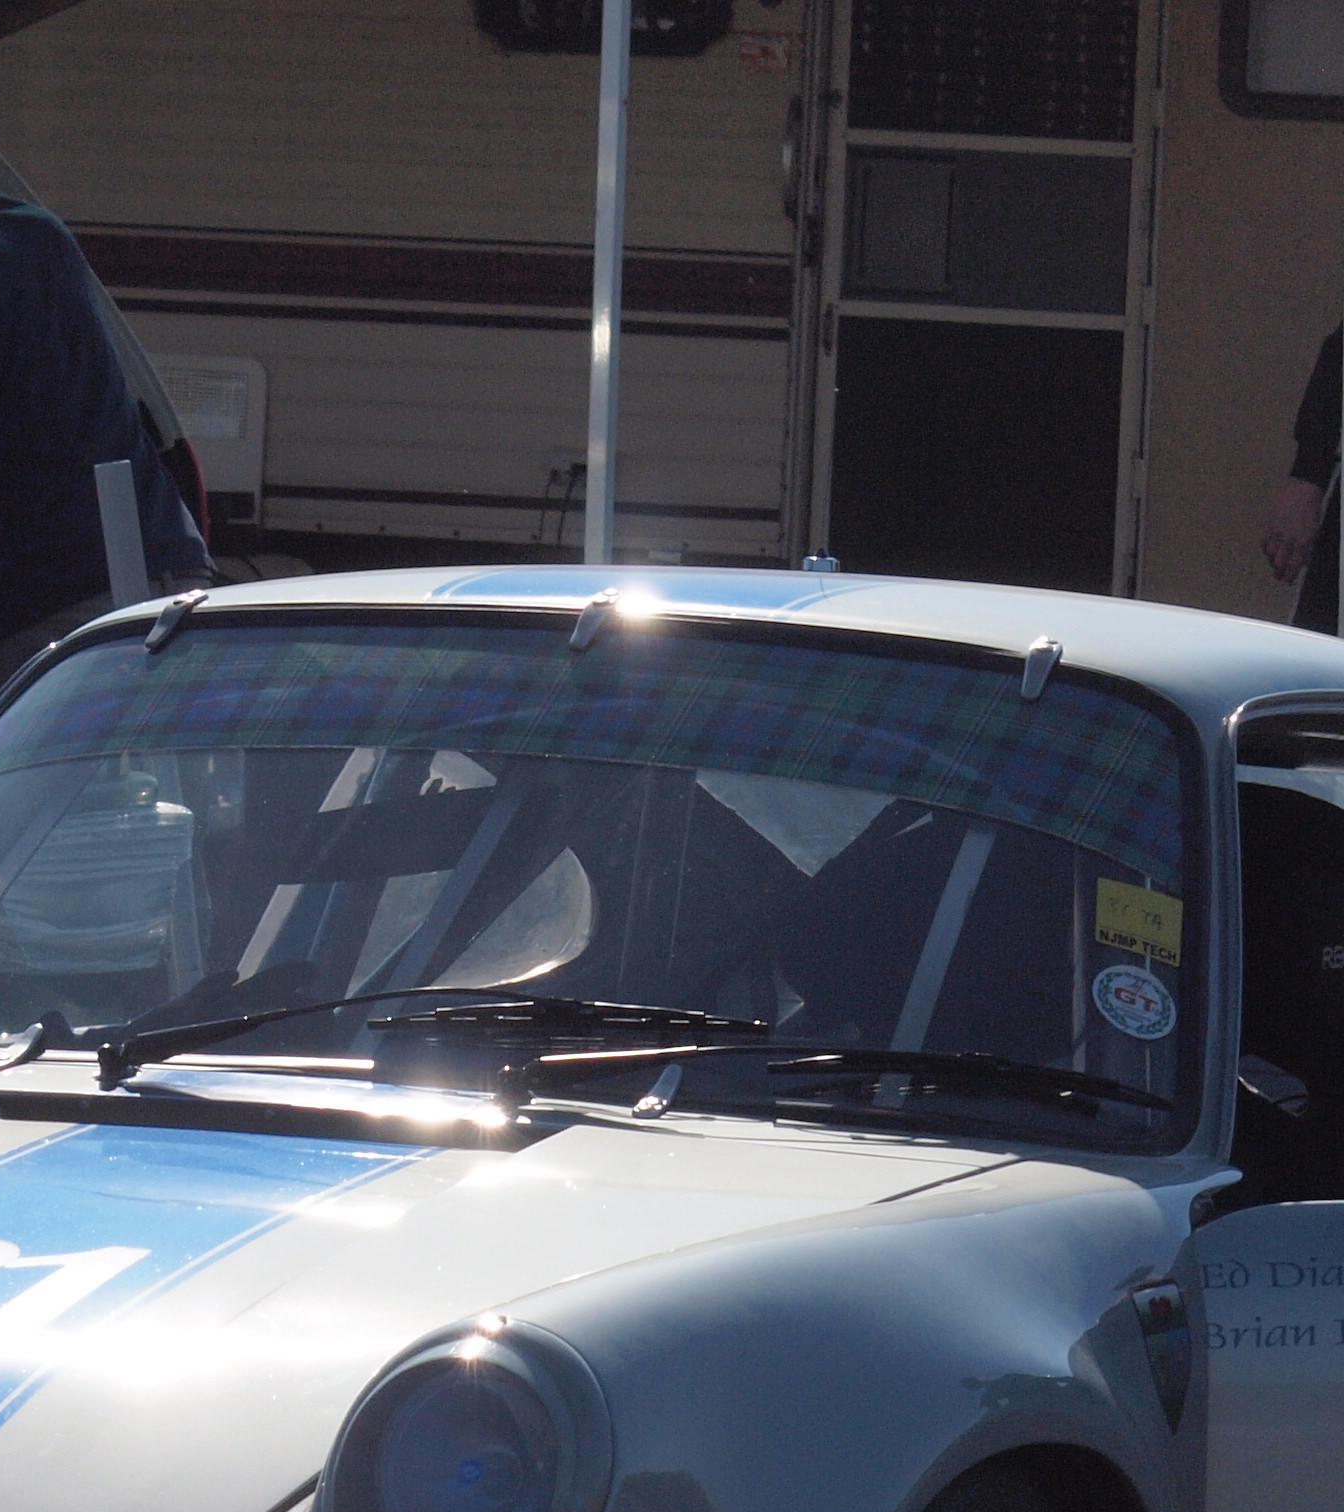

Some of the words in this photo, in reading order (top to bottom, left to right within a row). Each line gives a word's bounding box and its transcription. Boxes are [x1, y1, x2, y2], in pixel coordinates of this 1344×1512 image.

[1142, 941, 1176, 963] TECH
[1113, 985, 1159, 1013] GT
[1199, 1259, 1251, 1290] Ed
[1207, 1316, 1317, 1350] Brian
